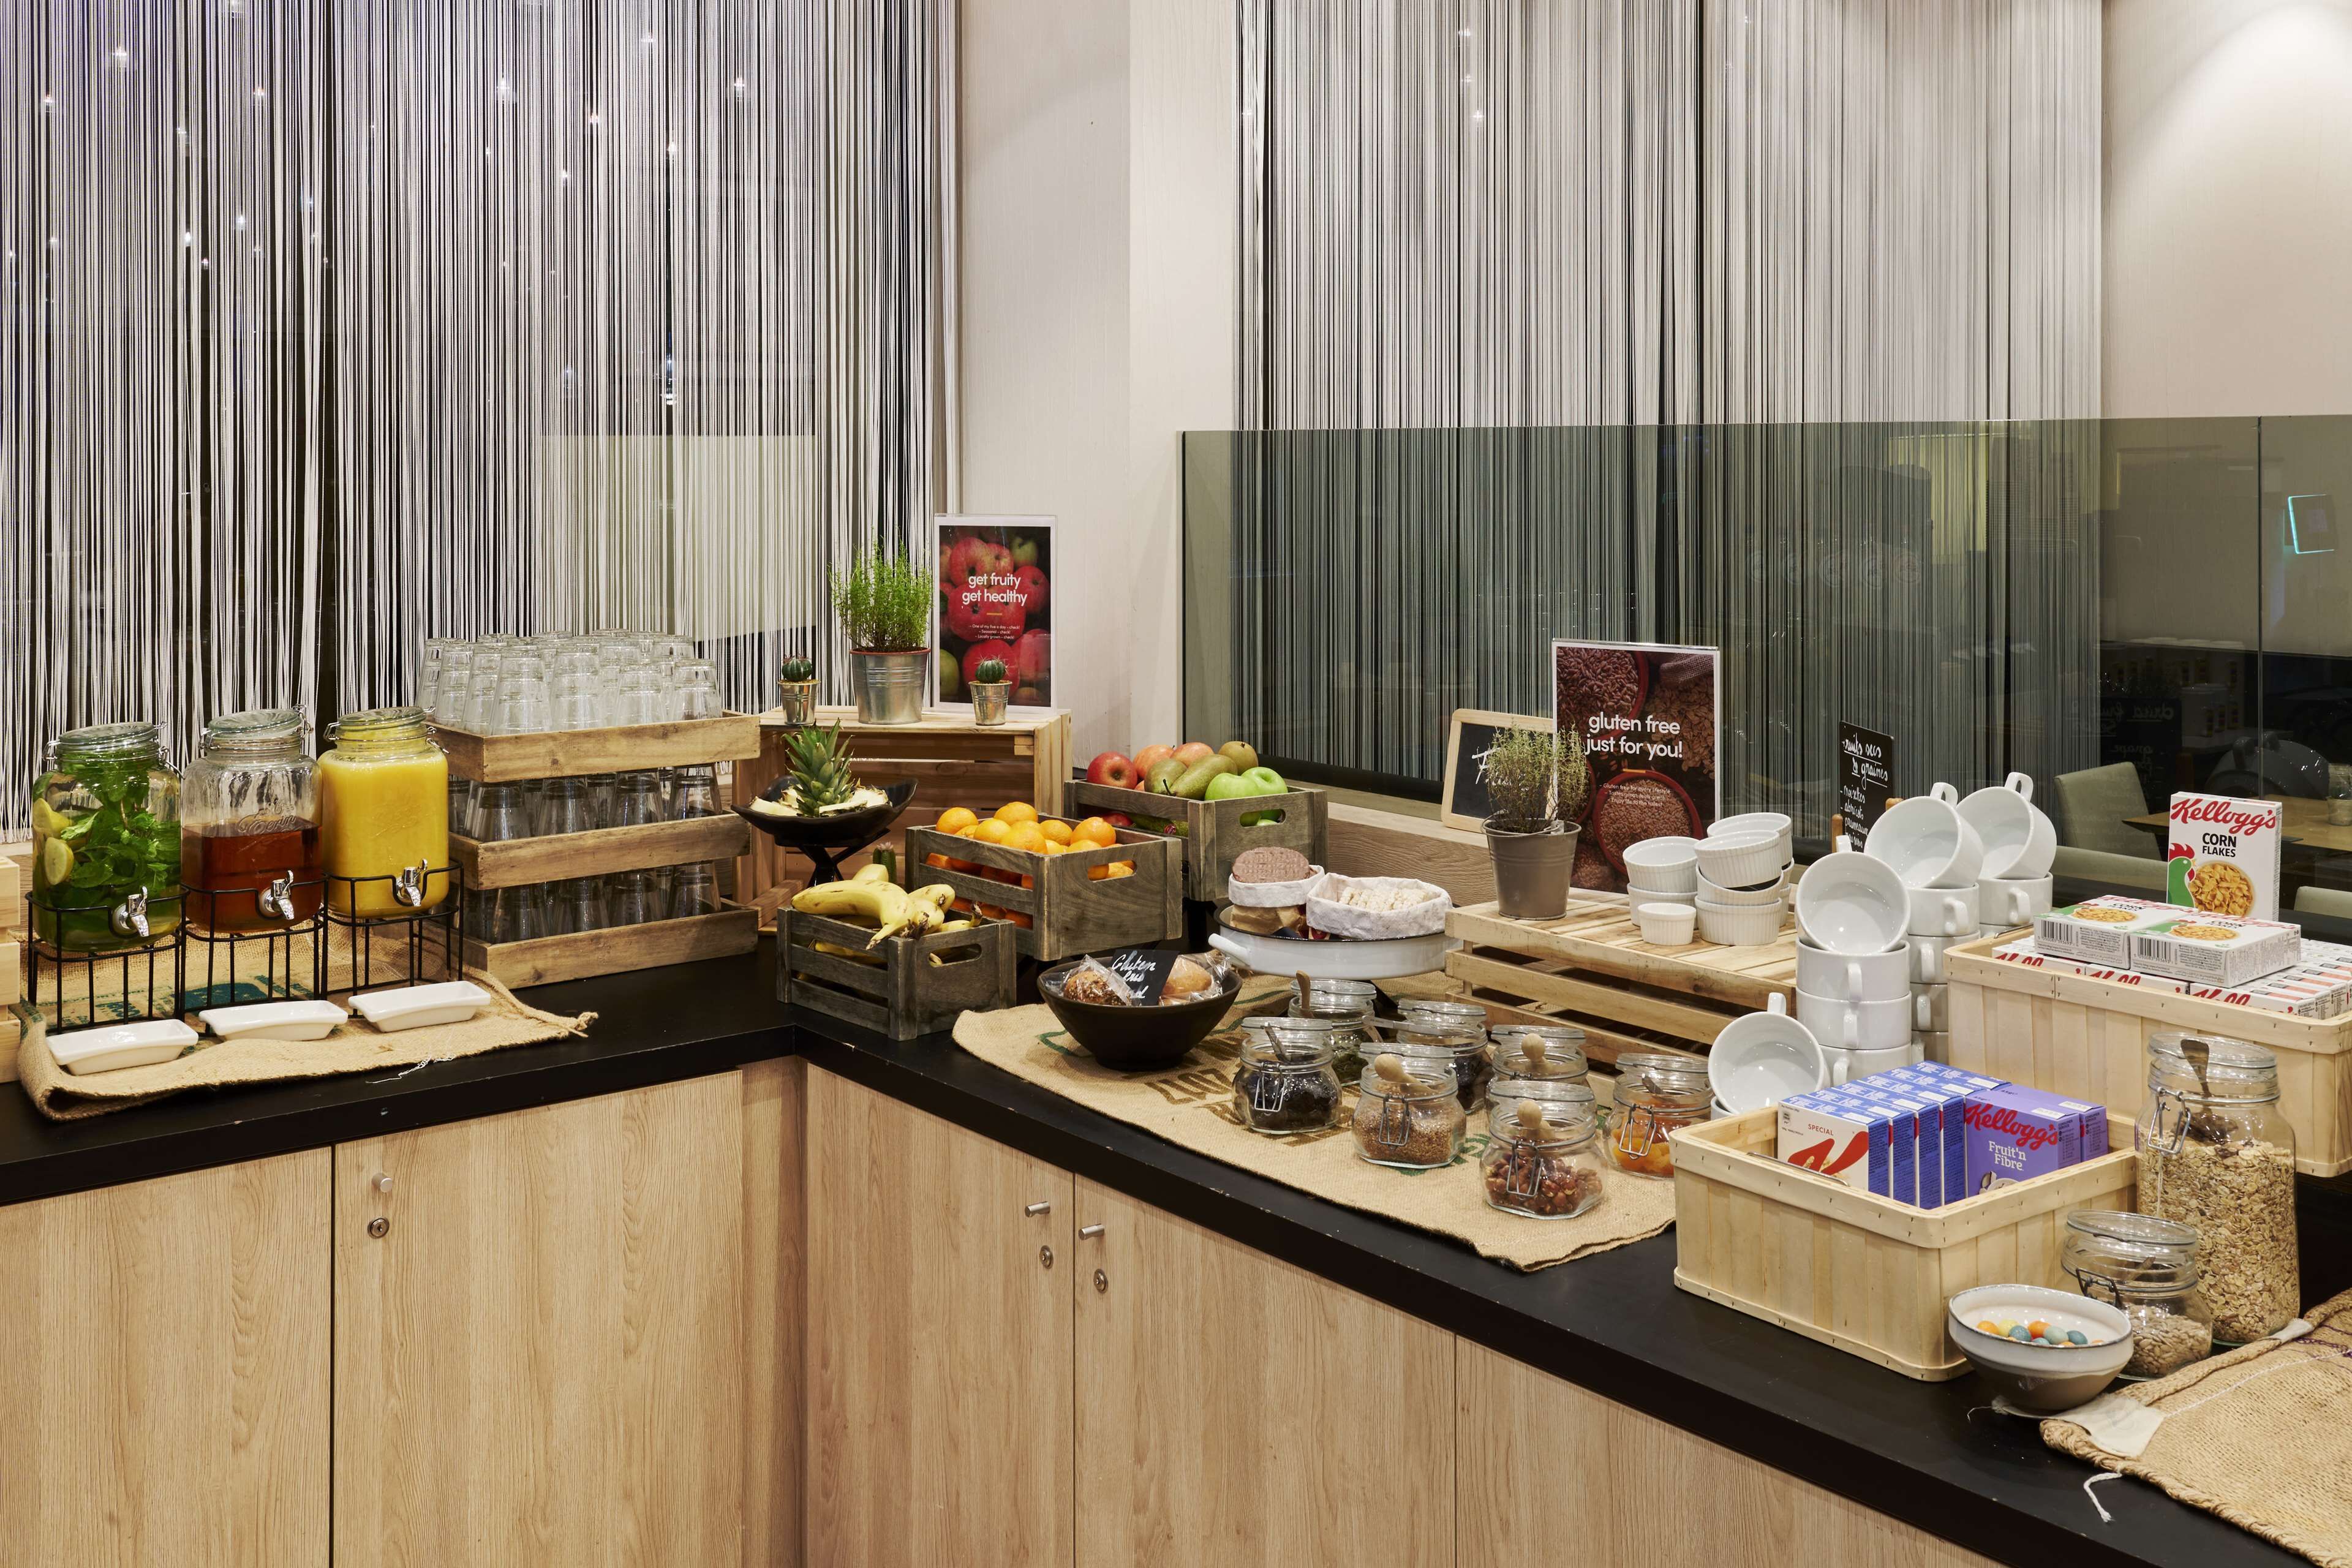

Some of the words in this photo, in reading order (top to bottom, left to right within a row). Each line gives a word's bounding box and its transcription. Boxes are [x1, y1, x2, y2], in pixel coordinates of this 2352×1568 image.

[968, 574, 988, 589] get
[990, 573, 1021, 589] fruity
[962, 590, 981, 605] get
[984, 589, 1028, 606] healthy
[1589, 712, 1642, 732] gluten
[1645, 715, 1681, 734] free
[1585, 733, 1616, 756] just
[1619, 736, 1643, 754] for
[1646, 741, 1683, 761] you!
[1842, 733, 1863, 755] ruits
[2171, 798, 2276, 836] Kellogg's
[2202, 832, 2237, 848] CORN
[2202, 846, 2236, 858] FLAKES
[1808, 1123, 1834, 1136] SPECIAL
[1965, 1102, 2059, 1151] Kellogg's
[1989, 1140, 2027, 1161] Fruit'n
[1994, 1153, 2023, 1170] Fibre
